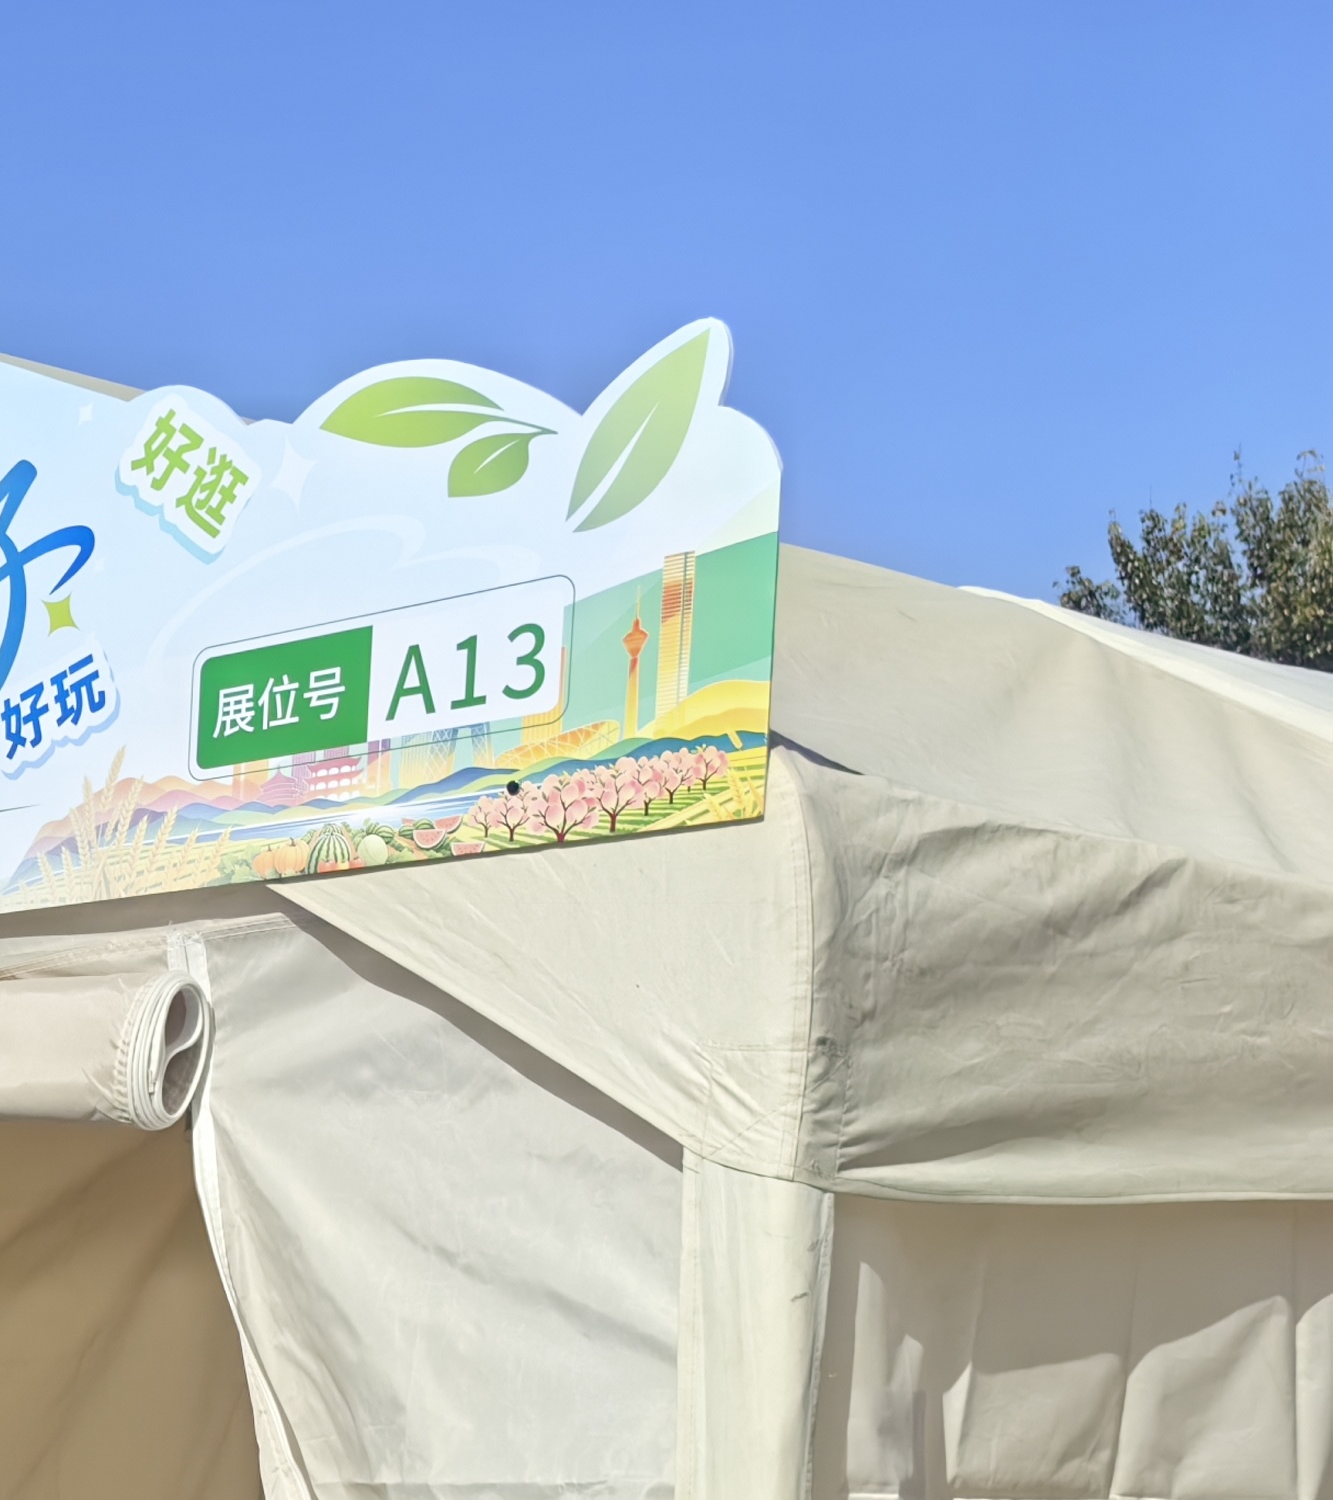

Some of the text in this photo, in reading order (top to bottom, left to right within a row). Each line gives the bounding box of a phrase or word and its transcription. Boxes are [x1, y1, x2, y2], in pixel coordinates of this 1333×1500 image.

[130, 408, 249, 539] 好逛
[1, 654, 106, 758] 好玩
[212, 622, 546, 740] 展位号 A13
